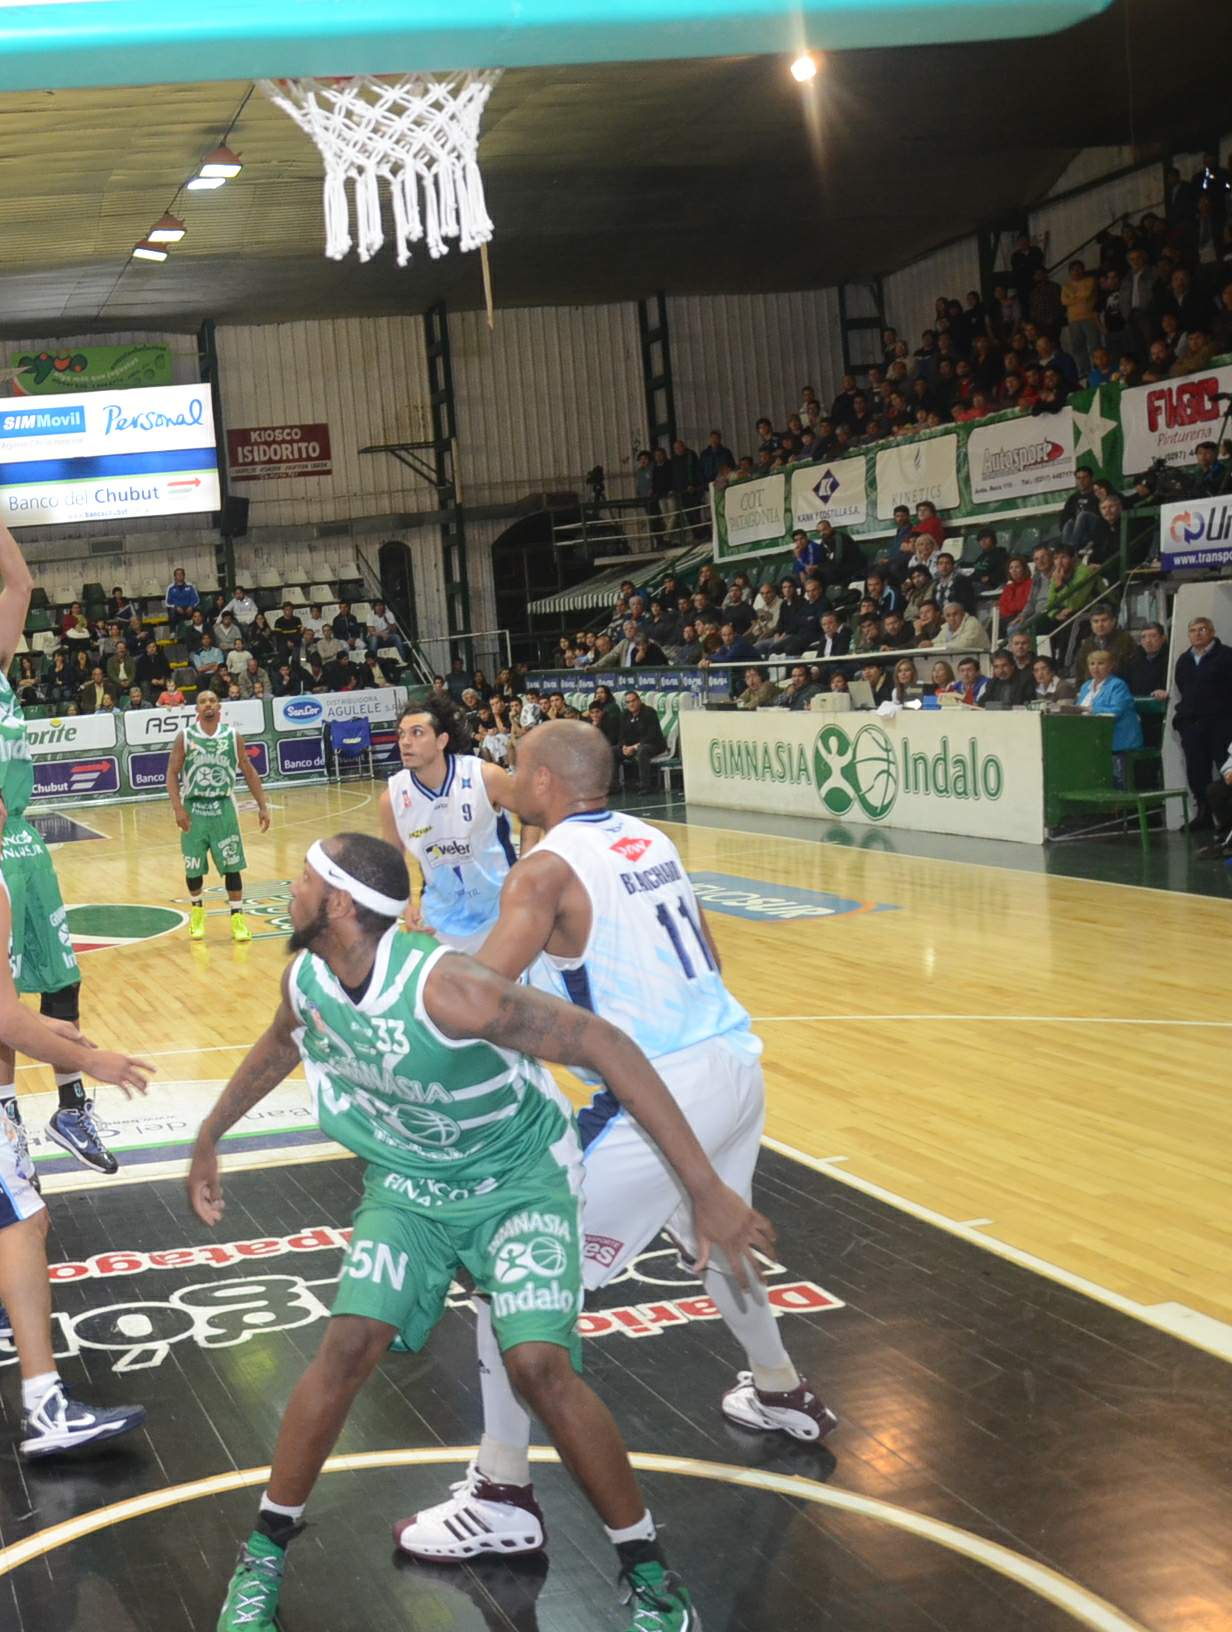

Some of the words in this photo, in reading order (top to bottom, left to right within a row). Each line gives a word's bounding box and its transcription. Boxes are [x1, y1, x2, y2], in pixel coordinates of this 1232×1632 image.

[102, 399, 203, 436] Personal
[250, 428, 302, 442] KIOSCO
[237, 441, 320, 463] ISIDORITO
[981, 438, 1053, 475] Autosport
[8, 495, 59, 512] Banco
[94, 487, 160, 504] Chubut
[891, 484, 942, 506] KINETICS
[1173, 551, 1232, 567] www.transp
[328, 703, 382, 717] AGULELE
[28, 726, 77, 745] prite
[284, 759, 312, 769] Banco
[709, 737, 812, 785] GIMNASIA
[902, 736, 1004, 801] Indalo
[32, 782, 68, 793] Chubut
[136, 773, 165, 784] Banco
[462, 803, 473, 822] 9
[184, 856, 201, 869] 5N
[656, 896, 718, 980] 11
[371, 1018, 410, 1055] 33
[348, 1239, 409, 1291] 5N
[493, 1281, 574, 1318] Indalo
